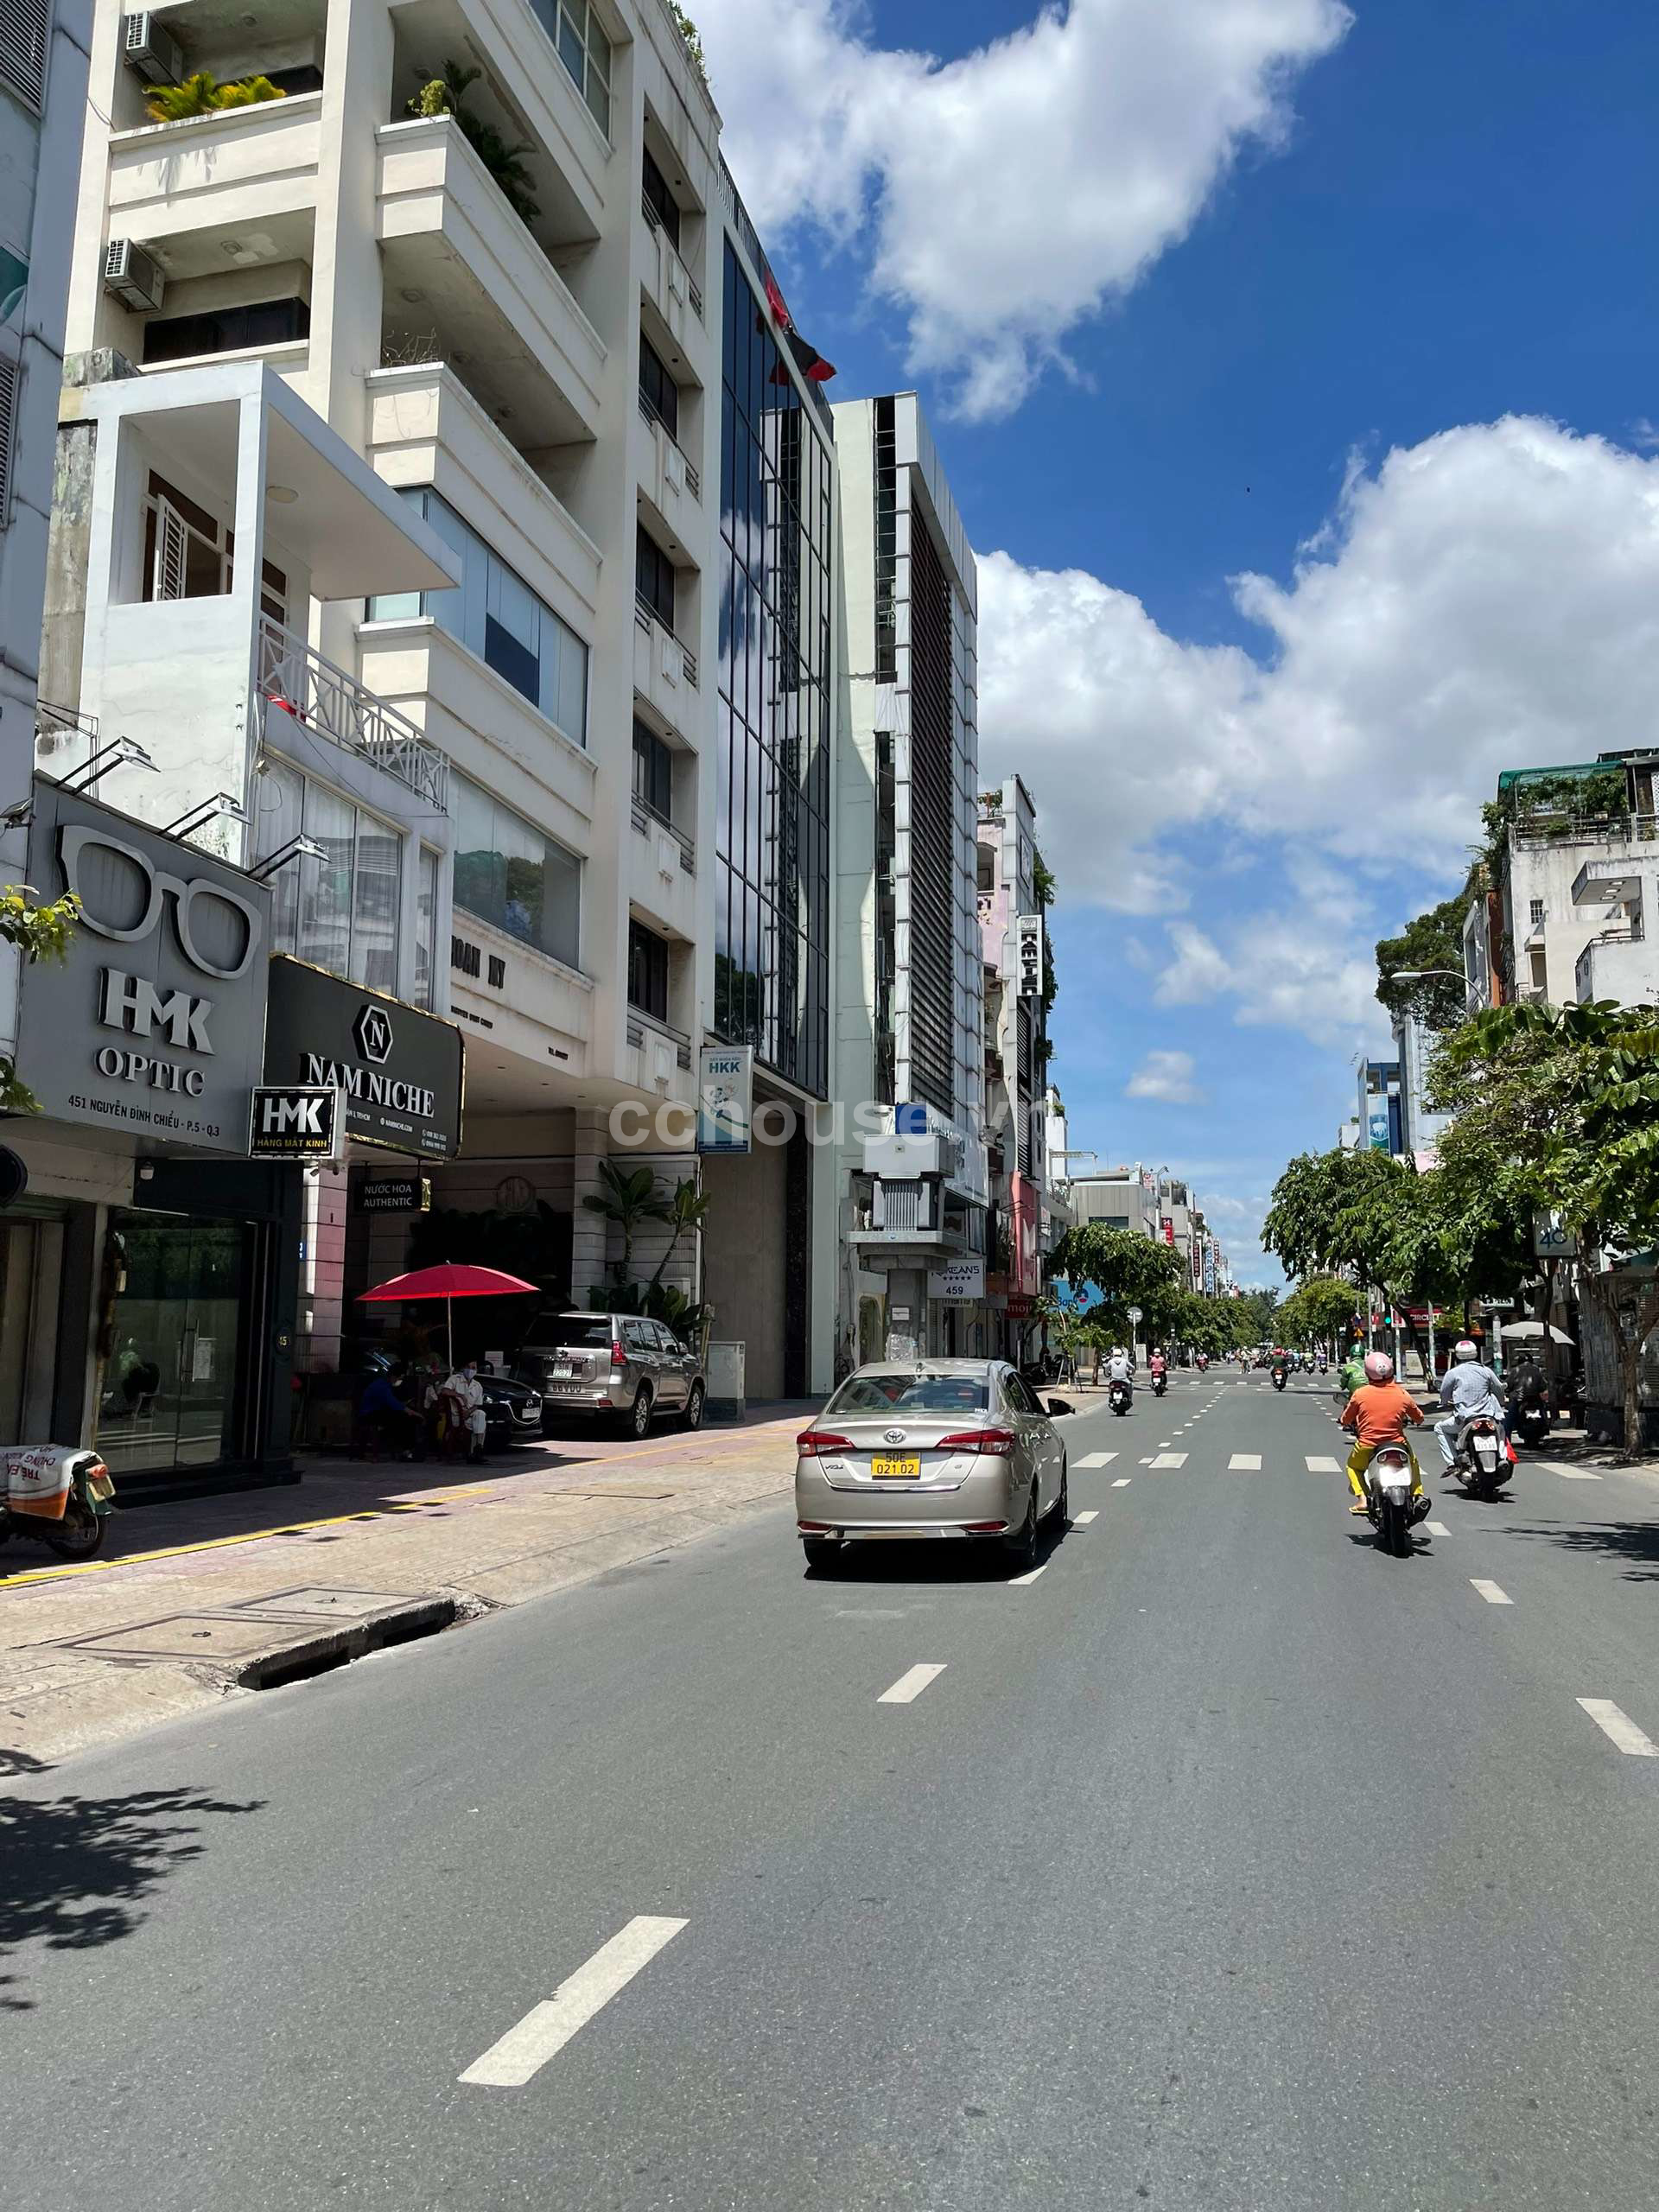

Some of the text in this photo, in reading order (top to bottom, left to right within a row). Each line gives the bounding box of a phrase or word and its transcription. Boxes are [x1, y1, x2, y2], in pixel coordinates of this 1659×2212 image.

[99, 967, 215, 1055] HMK
[369, 1020, 385, 1050] N
[98, 1046, 205, 1097] OPTIC
[709, 1061, 741, 1073] HKK
[306, 1052, 435, 1118] NAM NICHE
[68, 1094, 86, 1109] 451
[90, 1099, 127, 1118] NGUYỄN
[130, 1105, 151, 1122] ĐÌNH
[153, 1109, 180, 1128] CHIỂU
[187, 1124, 200, 1133] P.5
[207, 1125, 219, 1137] Q.3
[263, 1097, 325, 1133] HMK
[363, 1197, 413, 1207] AUTHENTIC
[365, 1183, 412, 1194] NƯỚC HOA
[945, 1286, 963, 1294] 459
[876, 1465, 914, 1475] 021.02
